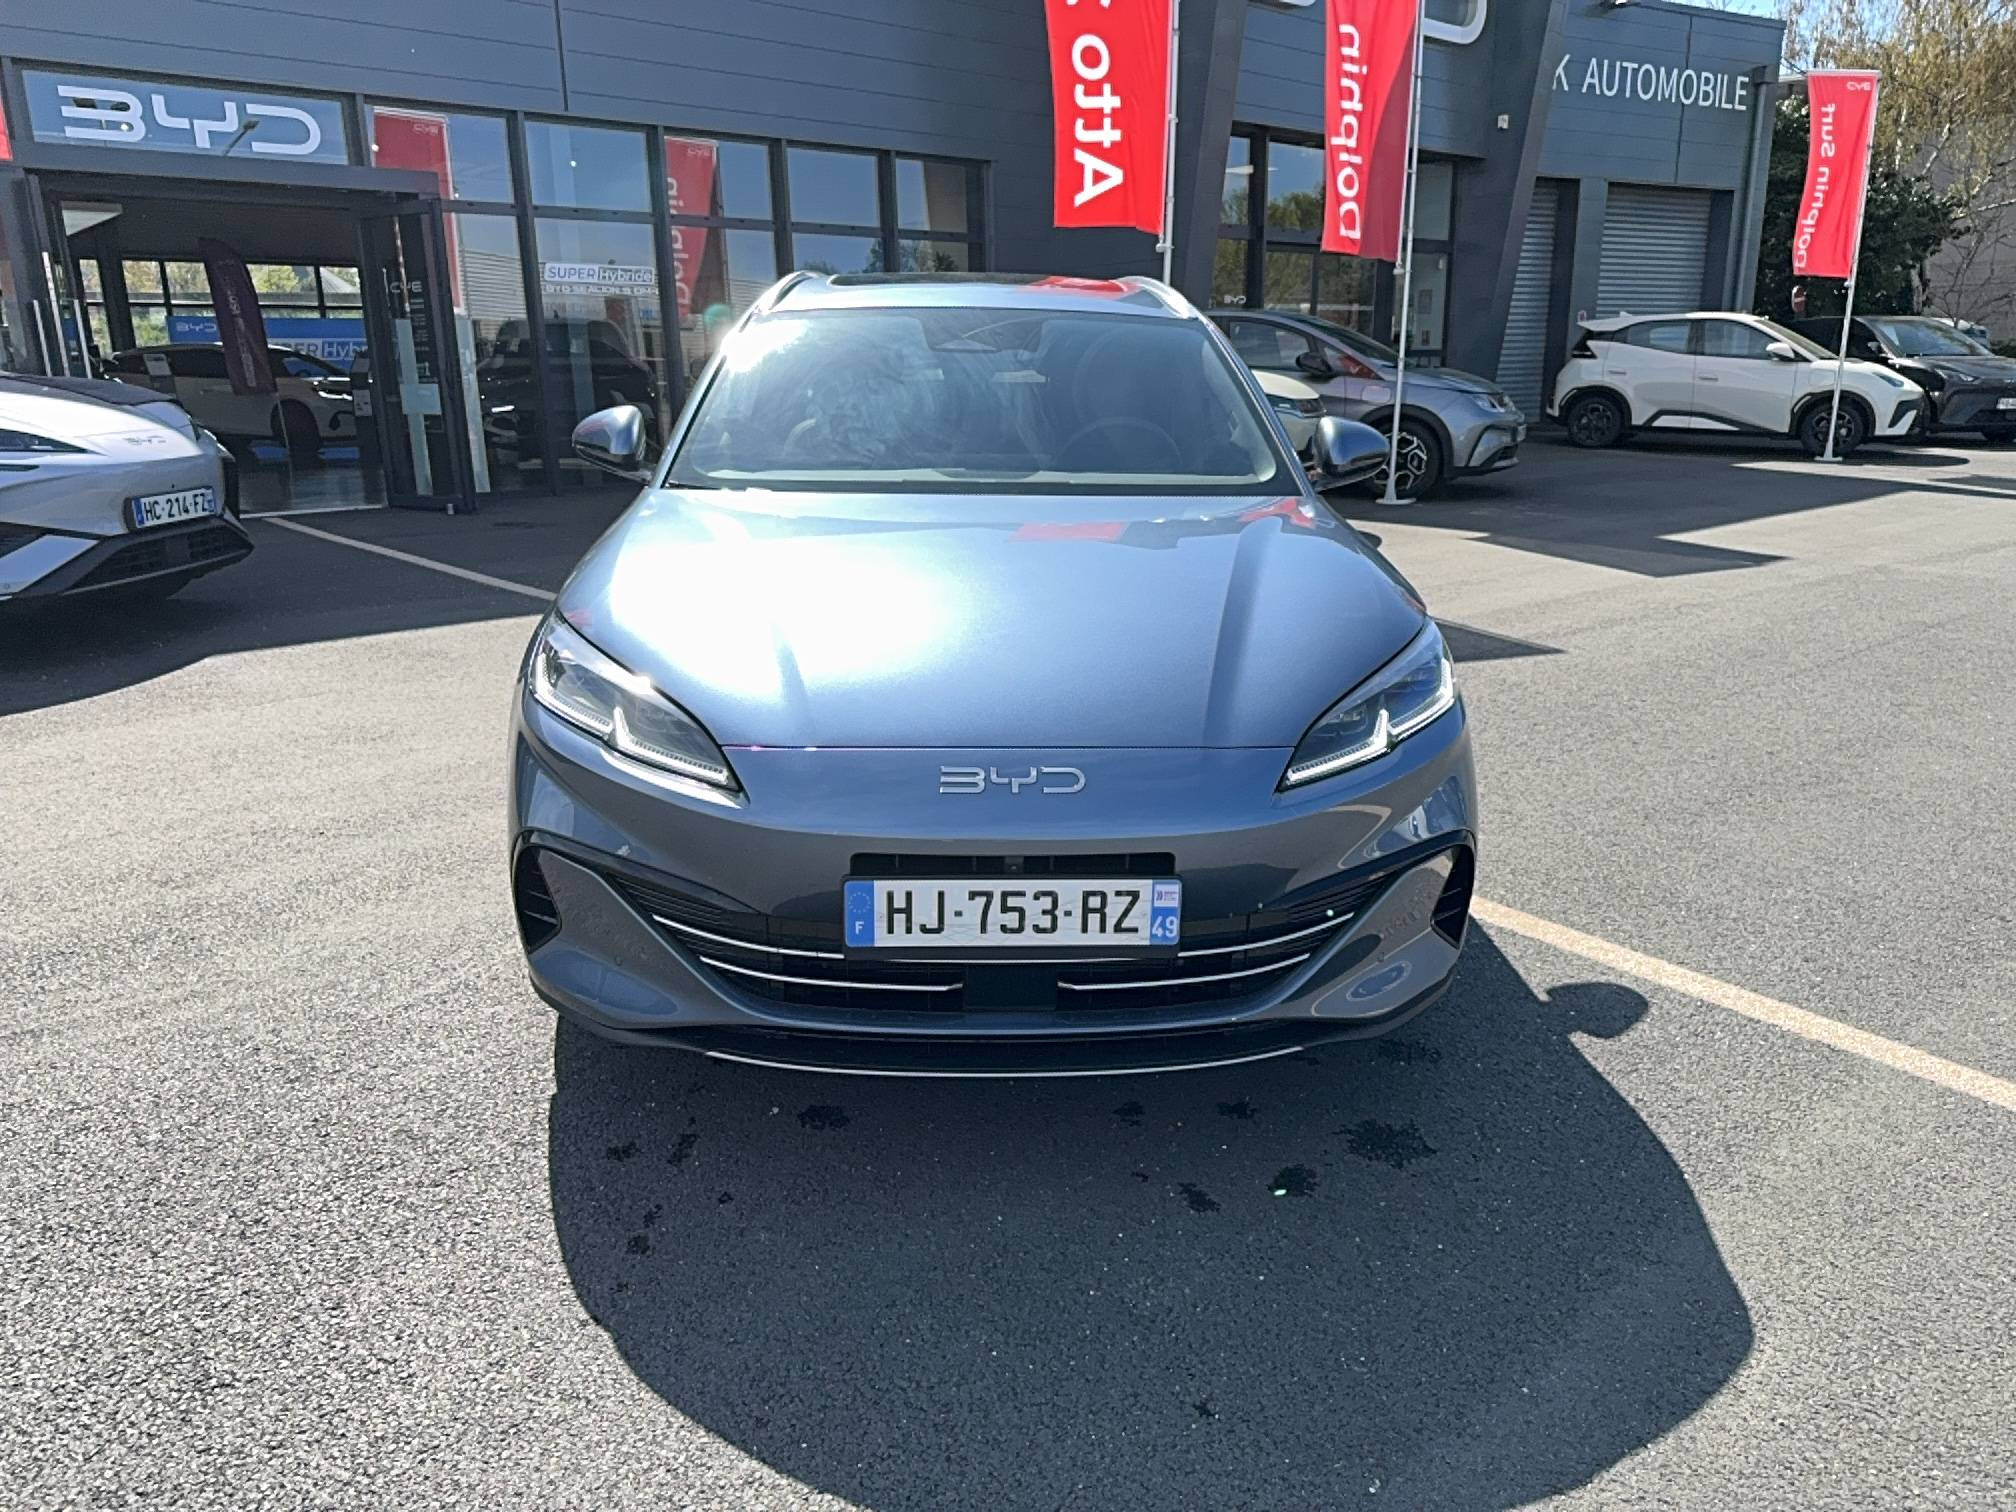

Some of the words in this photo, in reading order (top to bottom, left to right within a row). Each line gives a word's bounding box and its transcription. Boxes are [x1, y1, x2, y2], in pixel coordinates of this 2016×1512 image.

[1581, 57, 1750, 112] AUTOMOBILE
[57, 85, 321, 156] BYD
[548, 267, 595, 279] SUPER
[600, 269, 652, 282] Hybride
[176, 321, 217, 332] BYD
[143, 492, 208, 521] HC-214-FZ
[939, 765, 1086, 794] BYD
[886, 889, 1142, 935] HJ-753-RZ
[1152, 915, 1178, 938] 49
[854, 921, 865, 935] F
